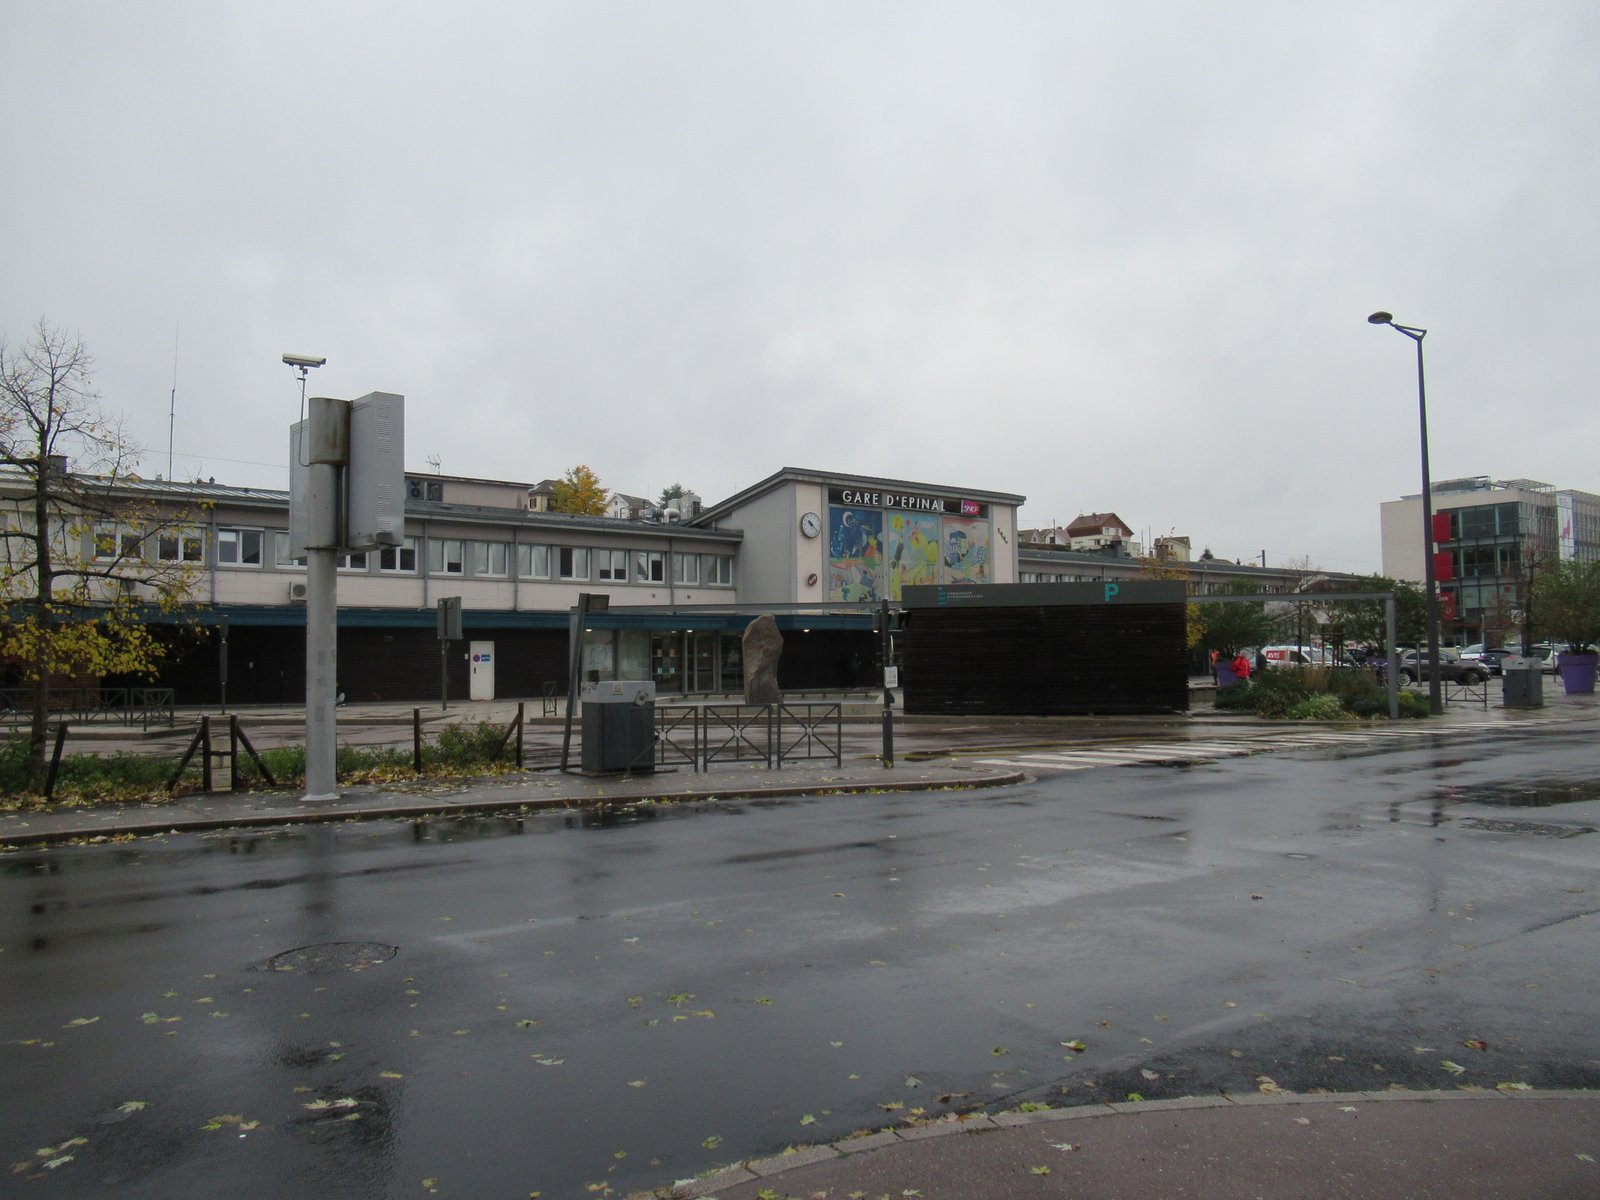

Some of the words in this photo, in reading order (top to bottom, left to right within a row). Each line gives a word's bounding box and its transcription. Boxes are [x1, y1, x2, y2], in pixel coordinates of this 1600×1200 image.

[842, 490, 879, 505] GARE
[886, 494, 946, 512] D'EPINAL
[963, 504, 979, 513] SNCF
[1104, 583, 1120, 602] P
